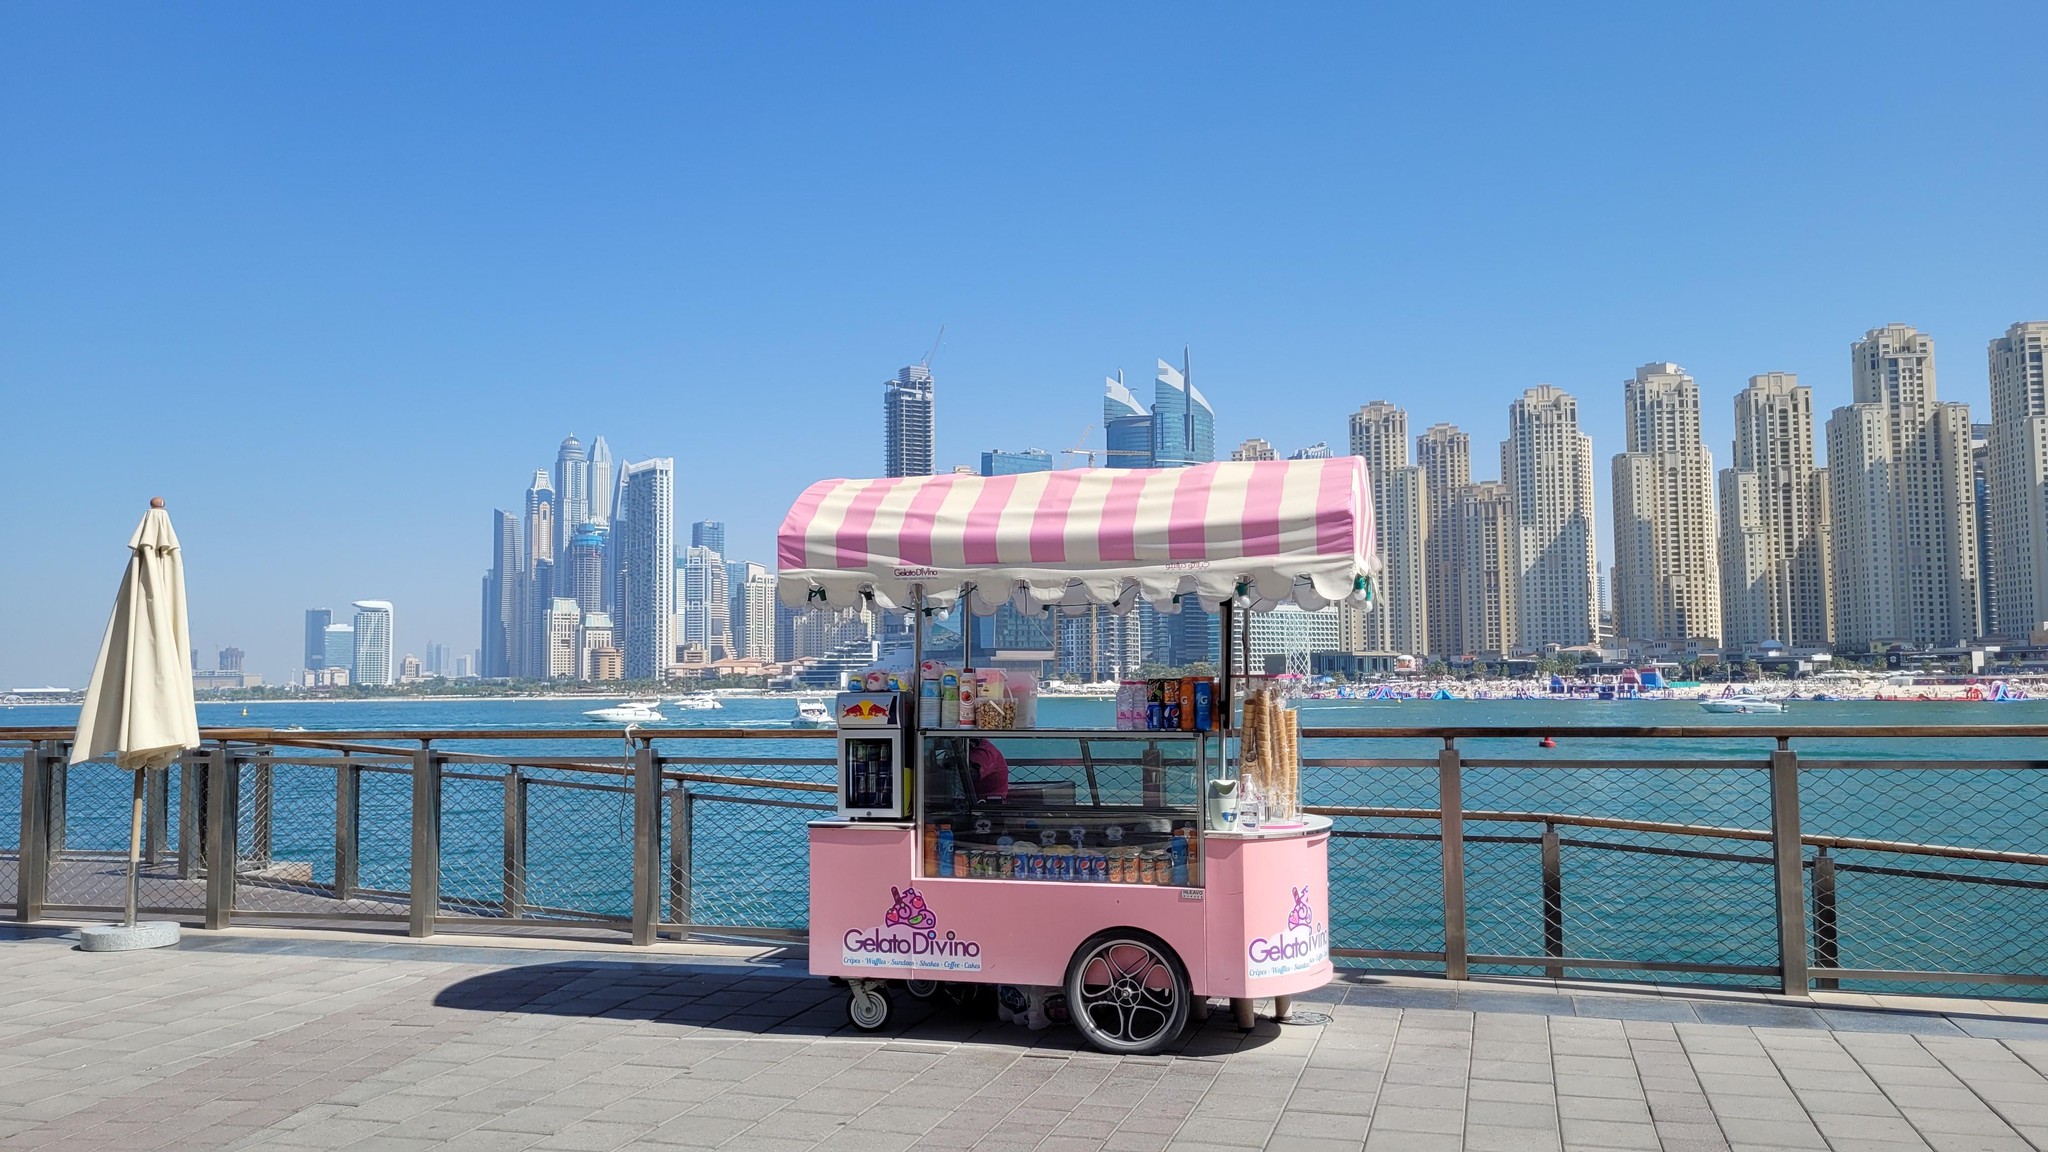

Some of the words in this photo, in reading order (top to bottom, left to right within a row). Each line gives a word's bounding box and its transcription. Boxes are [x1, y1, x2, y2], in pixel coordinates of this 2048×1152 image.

[1181, 696, 1188, 704] G
[1200, 695, 1208, 704] G
[865, 957, 886, 966] Waffles
